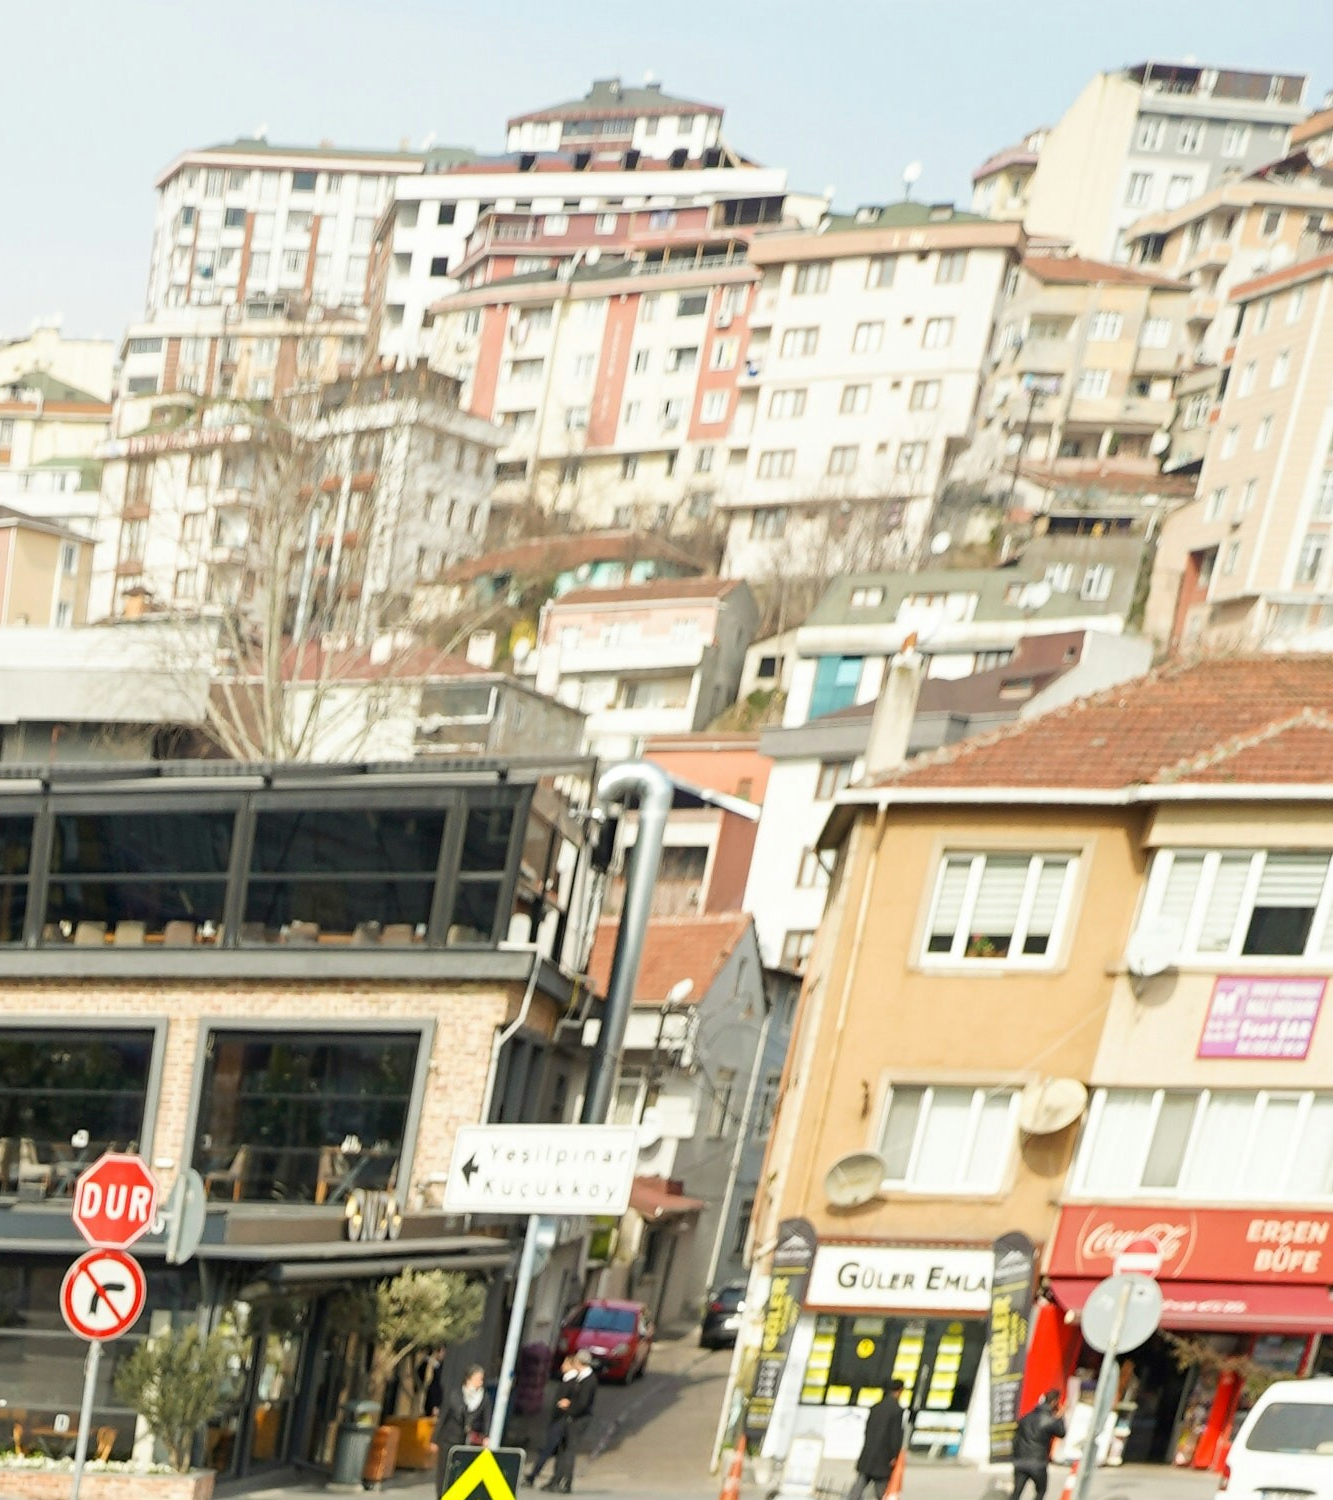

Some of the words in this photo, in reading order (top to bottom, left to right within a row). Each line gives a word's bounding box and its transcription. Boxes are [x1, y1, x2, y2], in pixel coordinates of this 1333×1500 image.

[80, 1181, 152, 1223] DUR
[837, 1262, 915, 1289] GÜLER
[926, 1267, 987, 1292] EMLA
